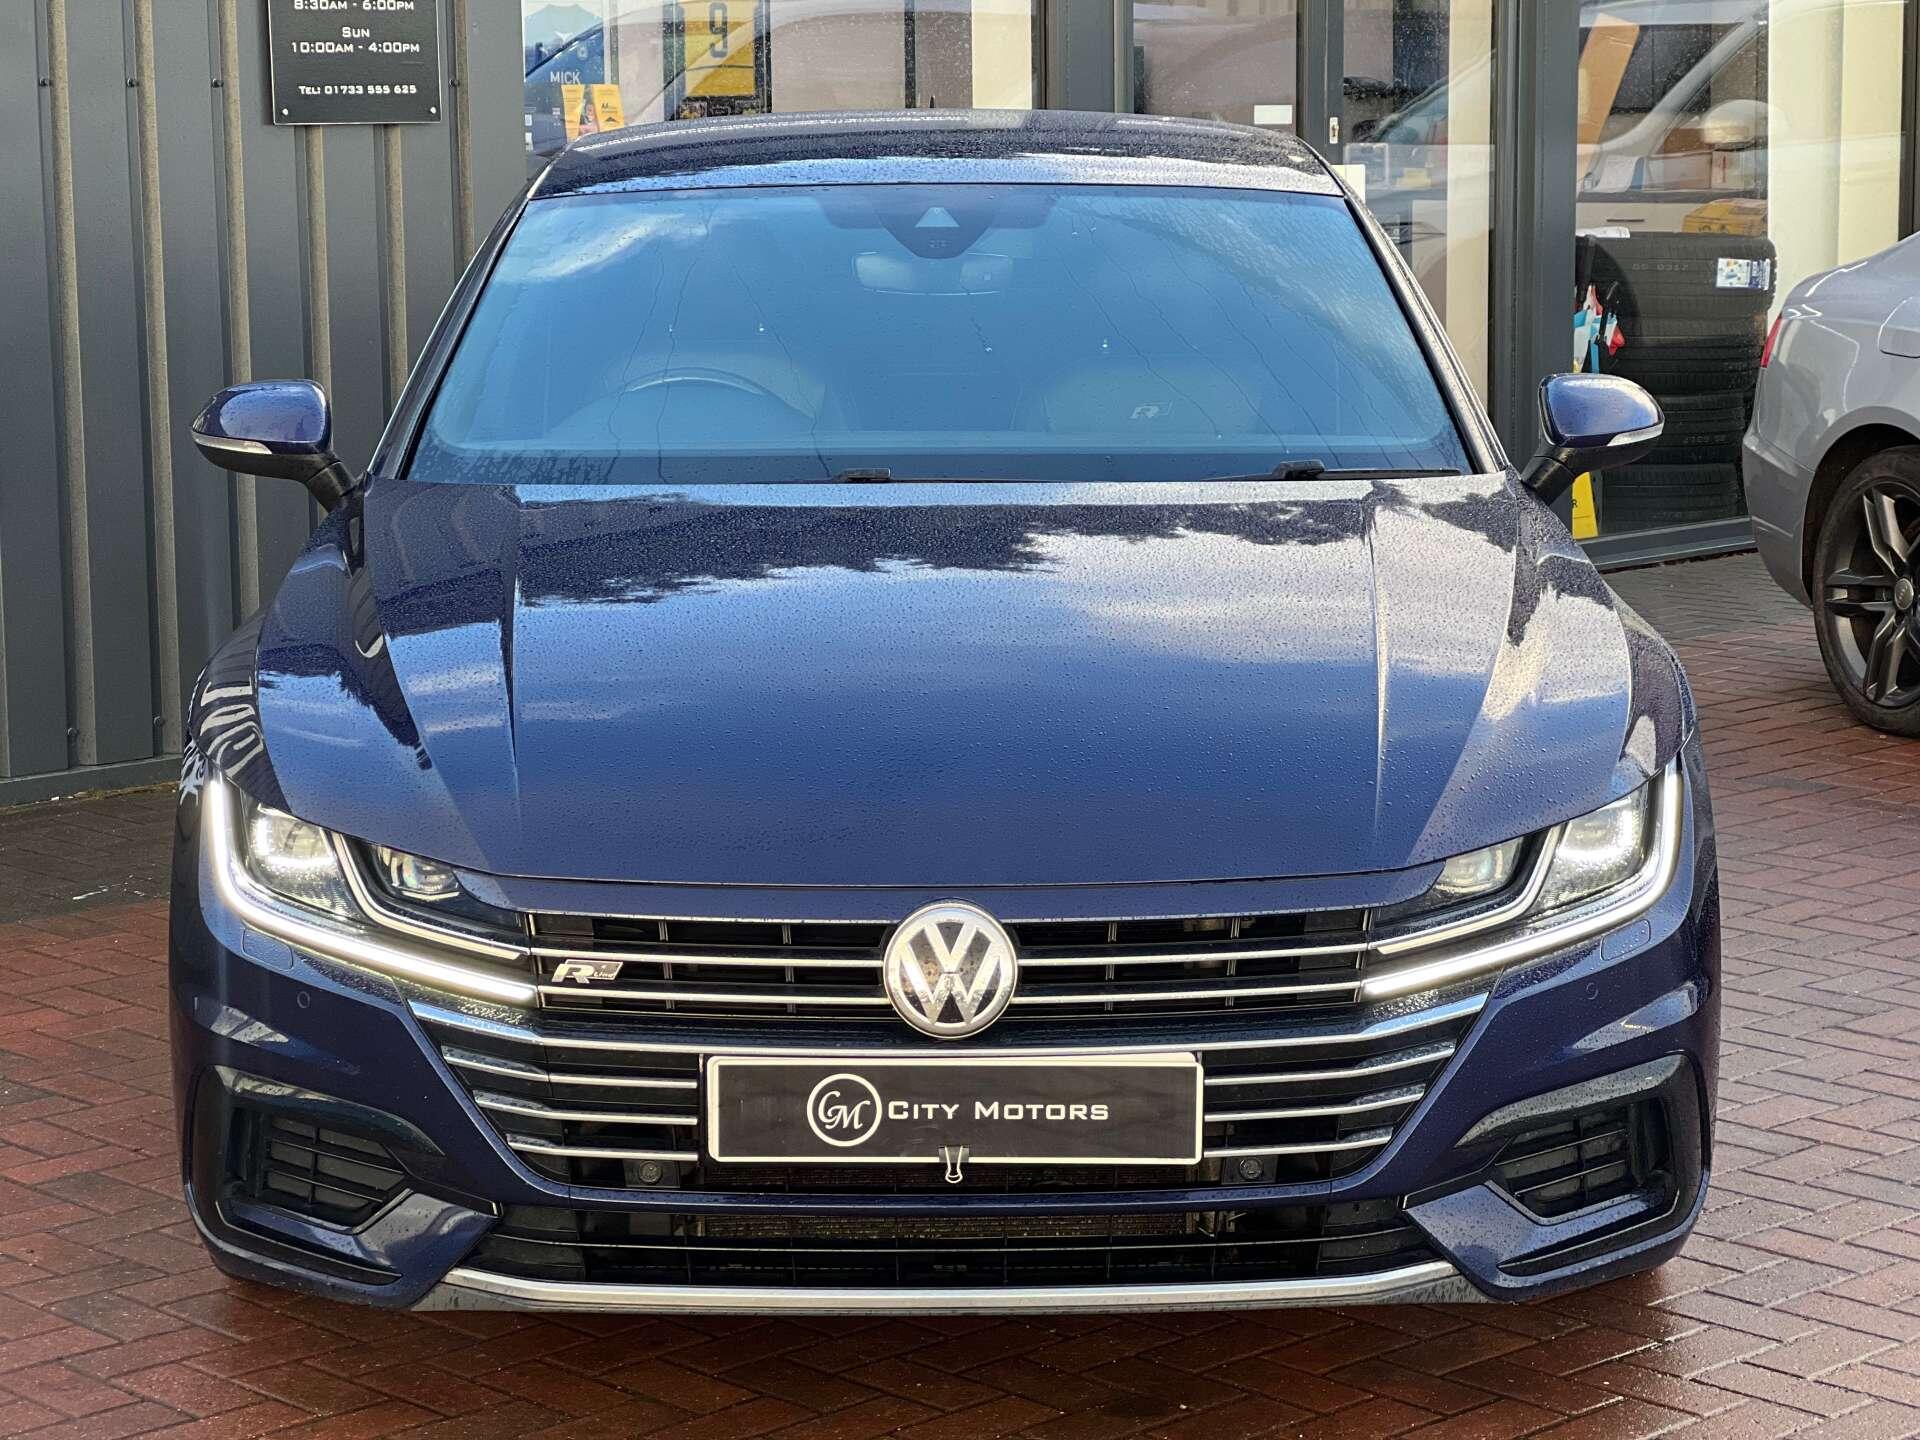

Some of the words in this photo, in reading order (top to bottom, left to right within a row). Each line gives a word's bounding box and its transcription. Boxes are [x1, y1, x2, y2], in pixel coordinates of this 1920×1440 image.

[291, 42, 354, 53] 10:00AM
[368, 42, 420, 53] 4:00PM
[550, 71, 580, 84] MICK
[324, 85, 364, 95] 01733
[367, 85, 390, 95] 555
[394, 85, 417, 94] 625
[974, 1102, 1109, 1121] MOTORS
